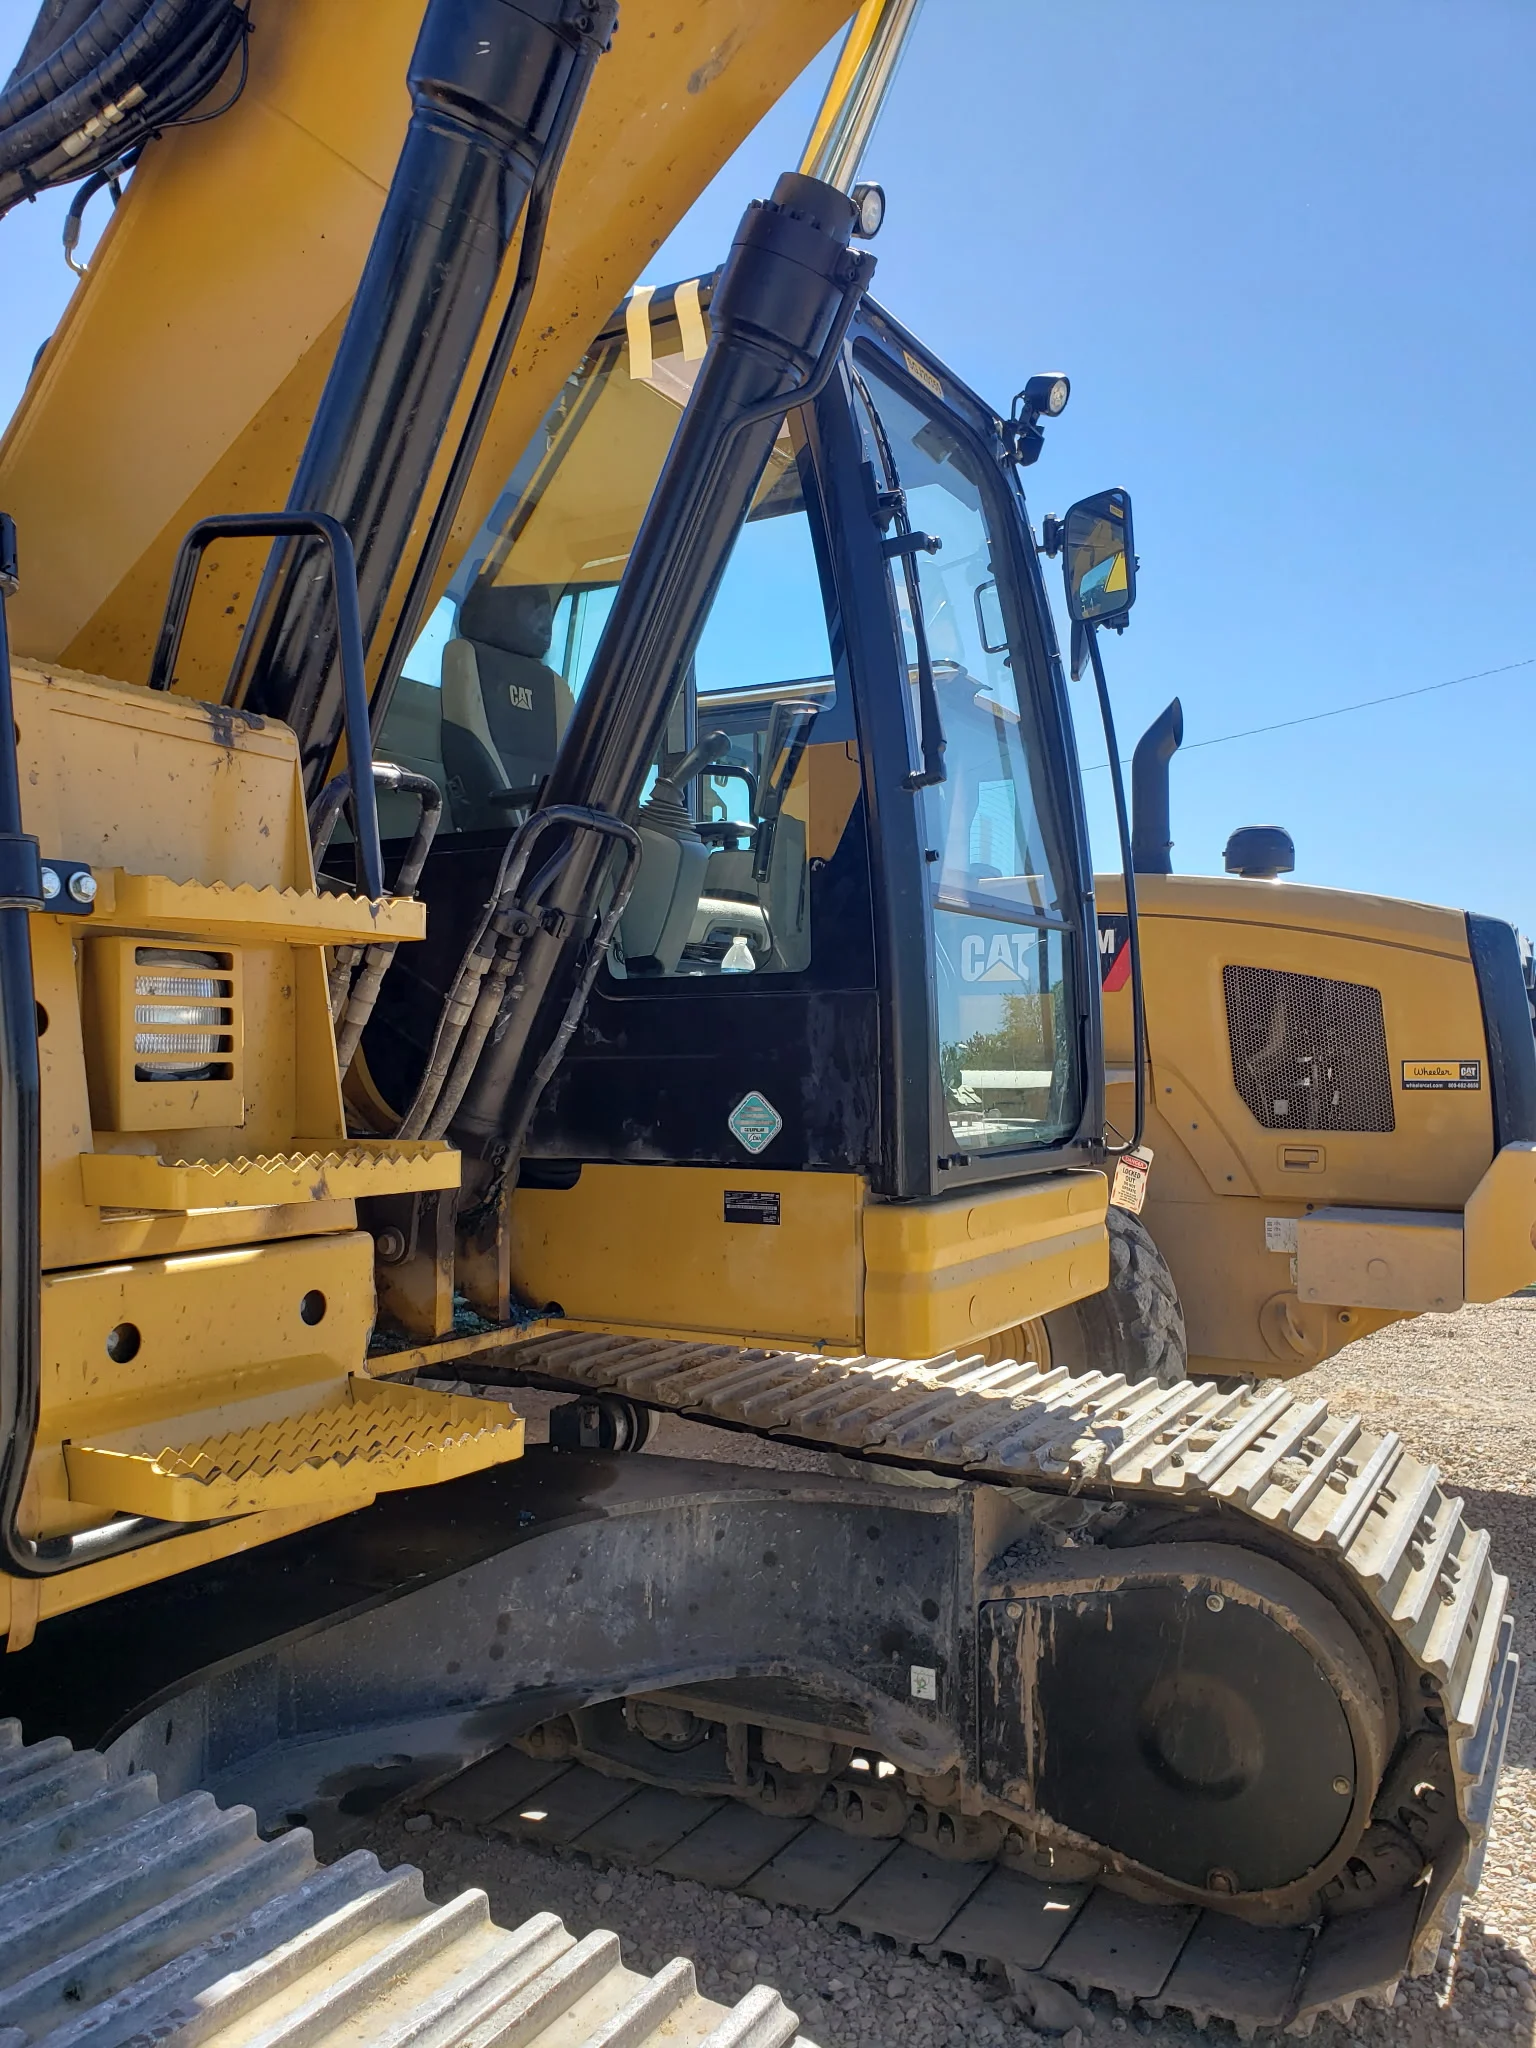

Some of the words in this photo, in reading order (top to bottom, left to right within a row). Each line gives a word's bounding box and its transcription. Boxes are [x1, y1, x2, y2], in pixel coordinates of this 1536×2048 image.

[509, 684, 533, 711] CAT
[961, 932, 1036, 982] CAT
[1413, 1067, 1452, 1076] Wheeler
[1460, 1067, 1476, 1077] CAT
[1125, 1157, 1144, 1168] DANGER
[1122, 1167, 1141, 1179] LOCKED
[1125, 1175, 1136, 1183] OUT
